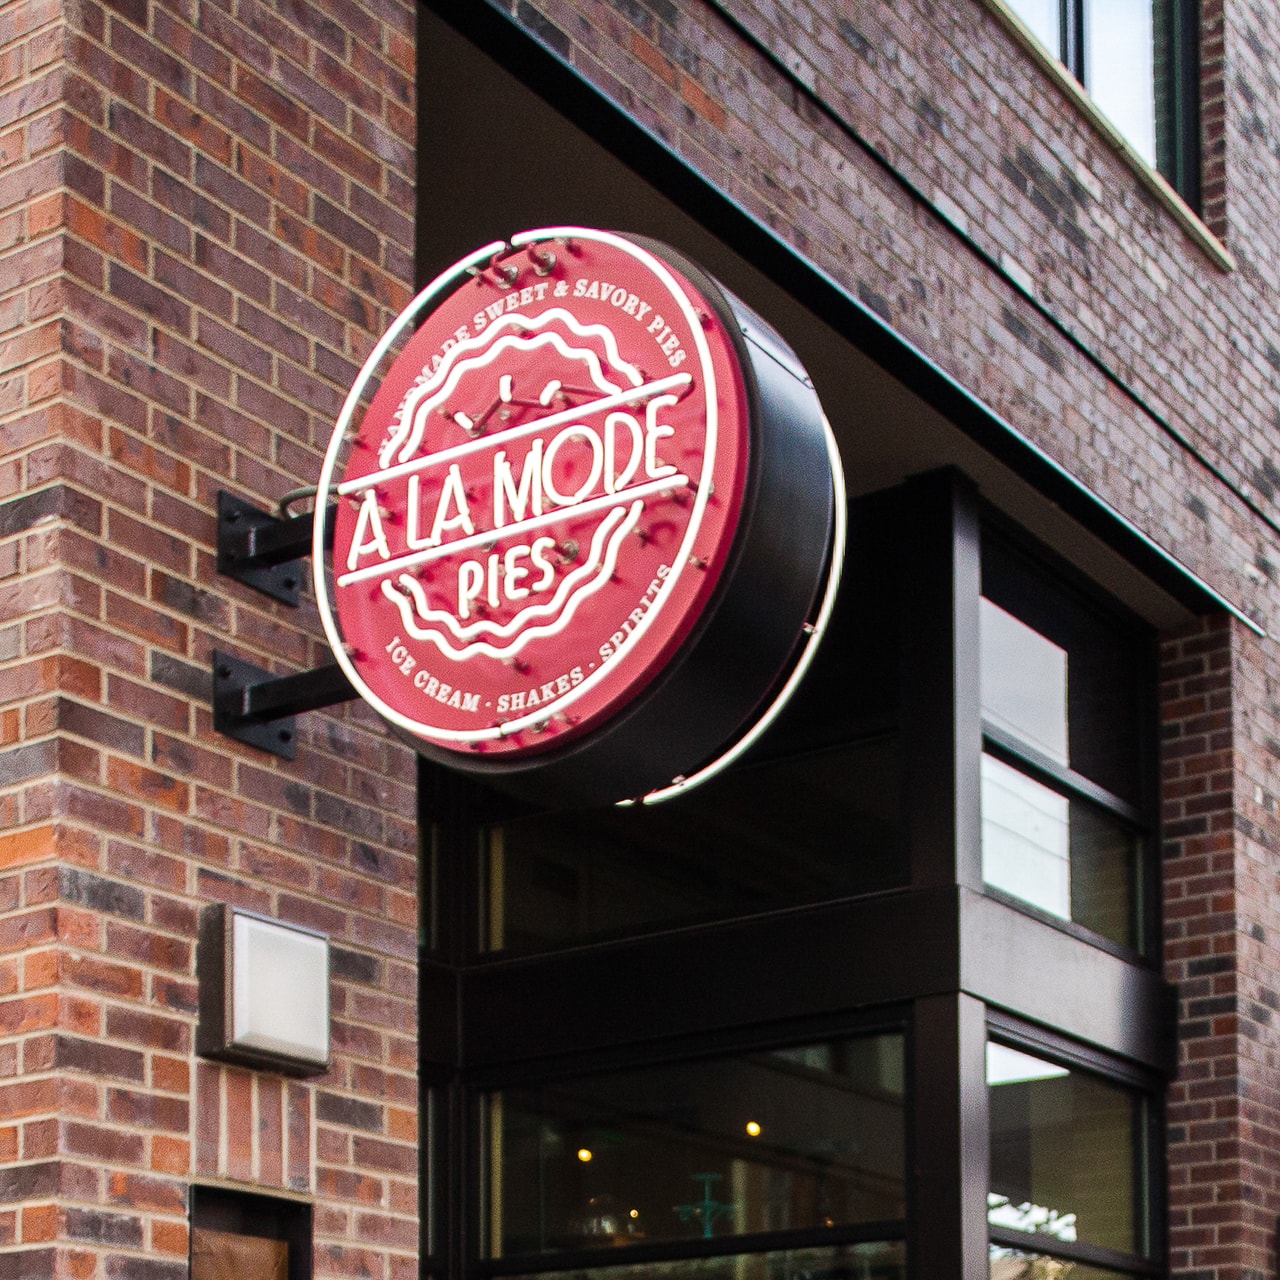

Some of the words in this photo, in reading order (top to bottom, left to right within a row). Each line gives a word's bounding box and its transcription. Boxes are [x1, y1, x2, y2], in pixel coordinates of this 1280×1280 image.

[473, 282, 549, 331] SWEET
[553, 280, 570, 298] &
[573, 278, 652, 322] SAVORY
[646, 314, 687, 368] PIES
[346, 488, 392, 572] A
[406, 463, 475, 551] LA
[492, 394, 679, 529] MODE
[384, 635, 418, 676] ICE
[413, 669, 481, 713] CREAM
[496, 665, 585, 713] SHAKES
[598, 563, 672, 664] SPIRITS
[457, 537, 557, 620] PIES
